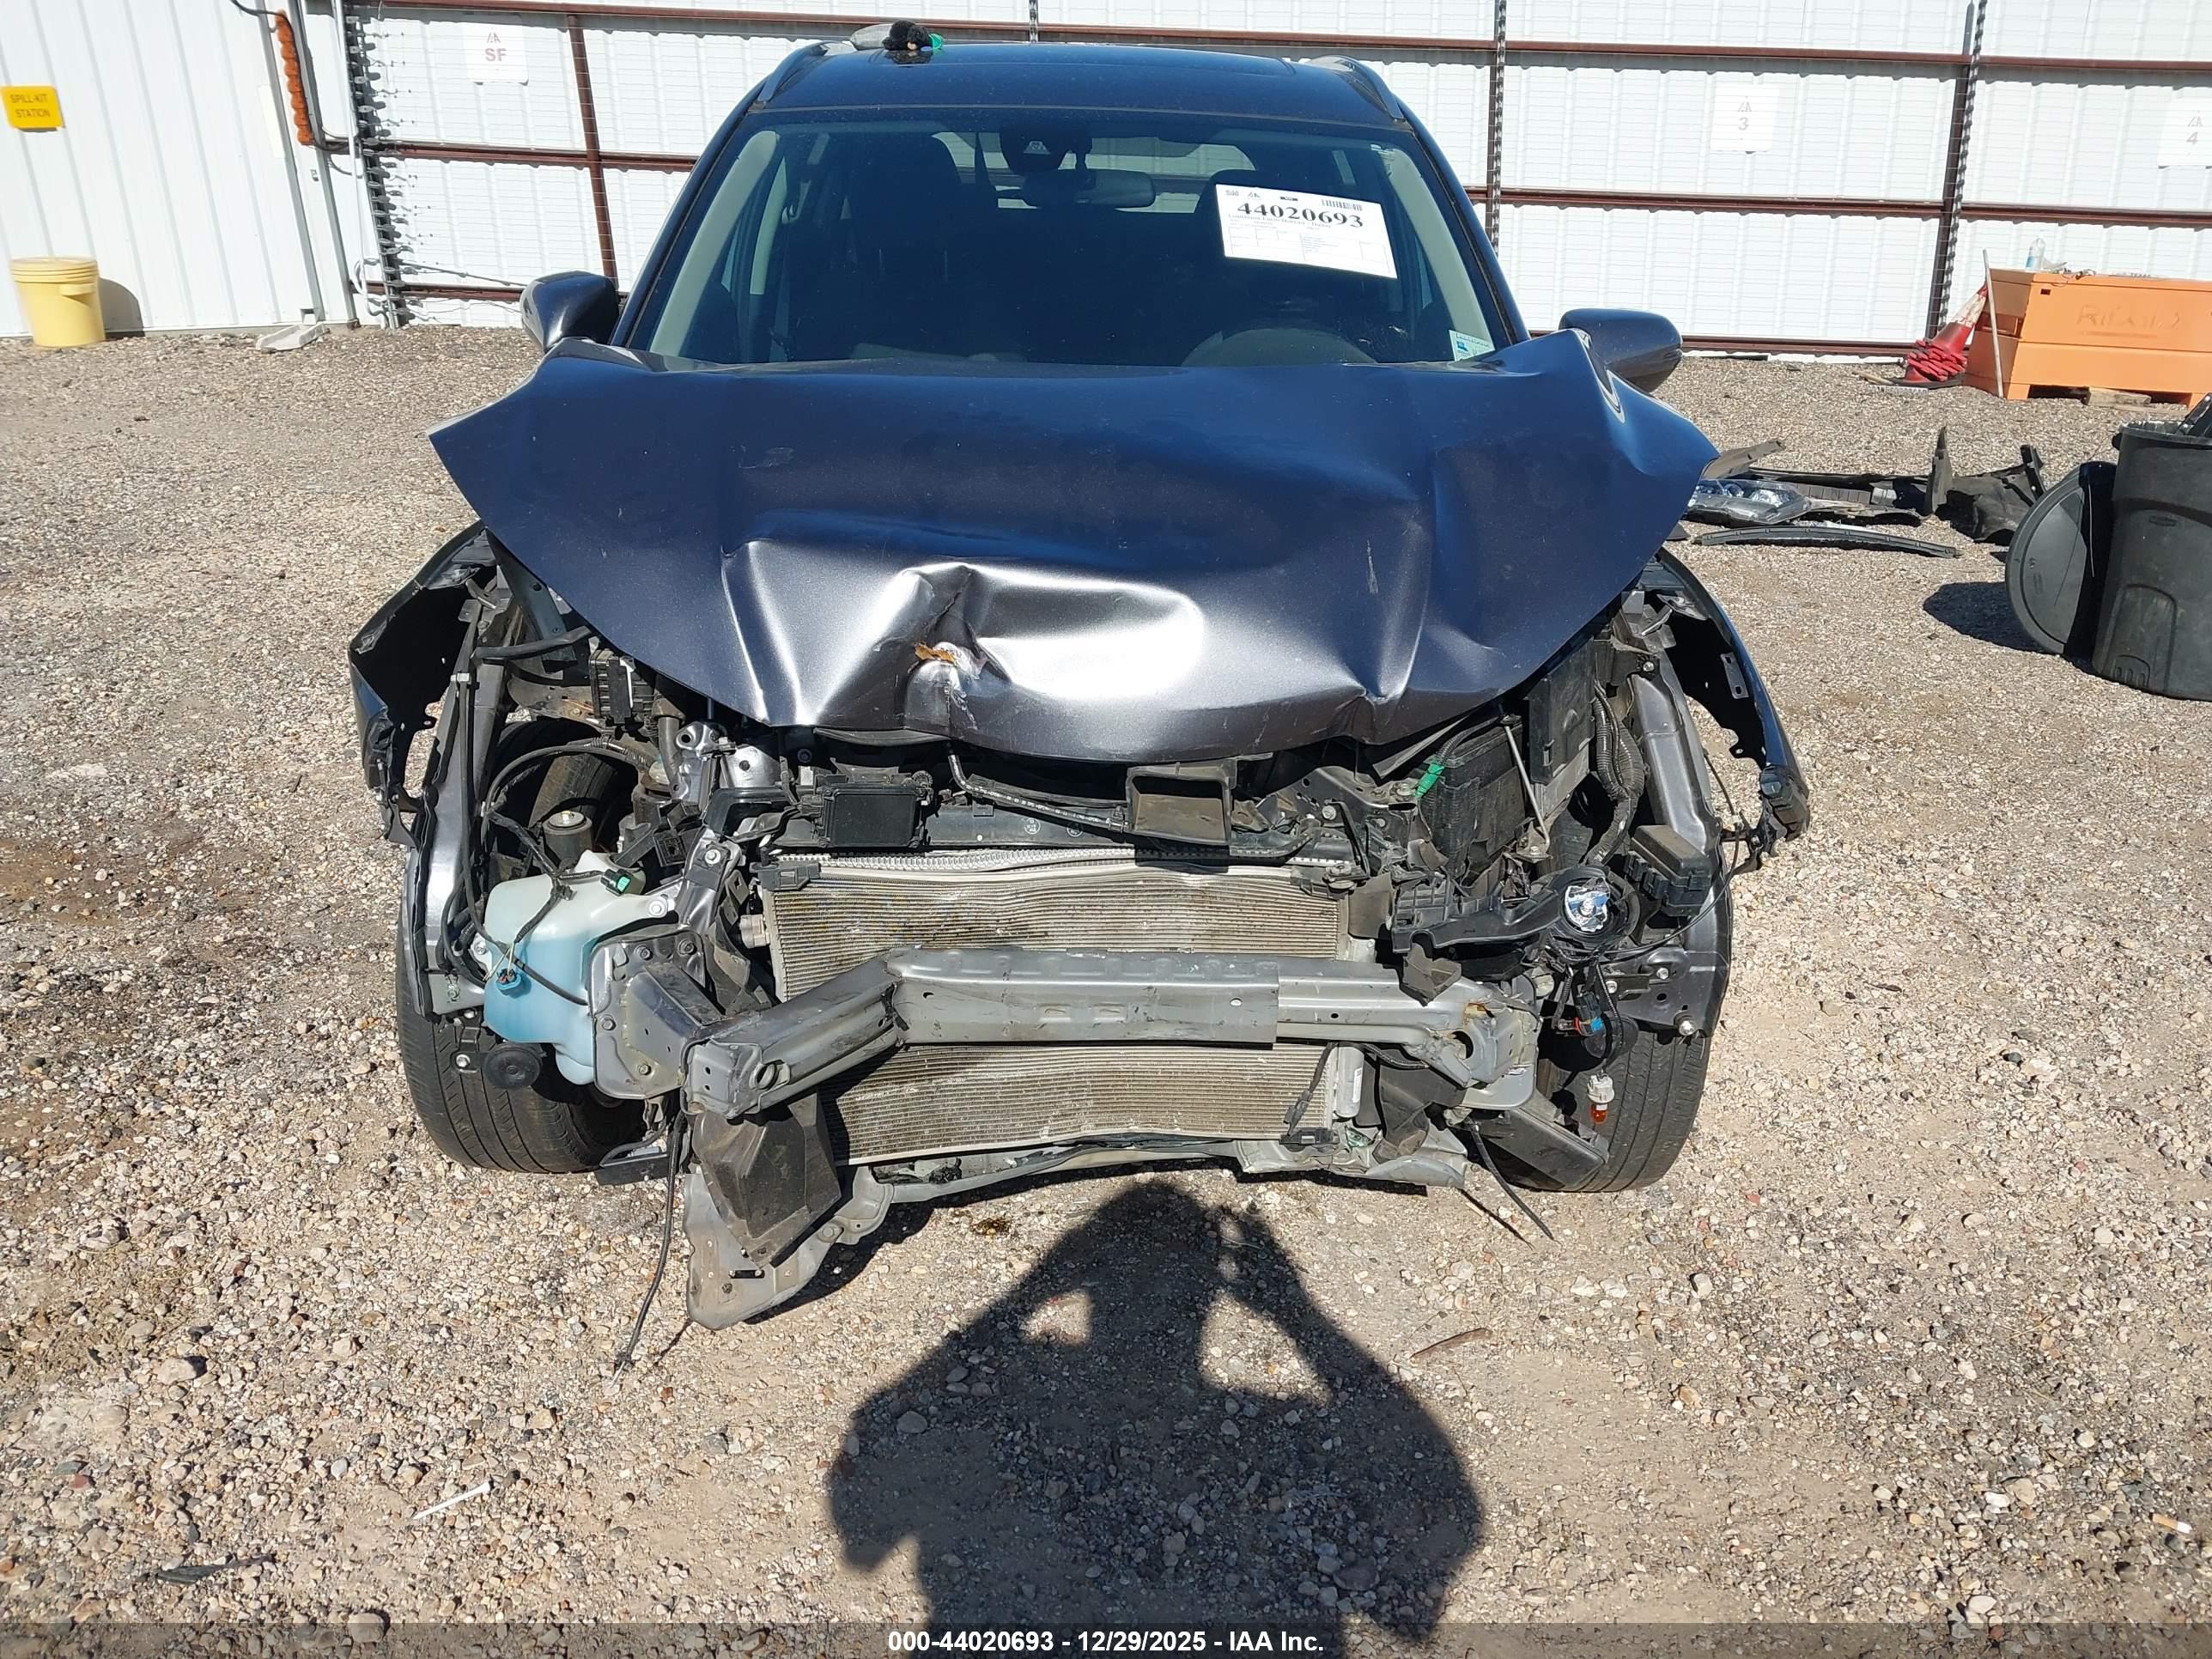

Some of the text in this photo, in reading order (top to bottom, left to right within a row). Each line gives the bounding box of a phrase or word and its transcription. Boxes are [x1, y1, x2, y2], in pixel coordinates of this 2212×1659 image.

[485, 47, 507, 62] SF
[15, 108, 52, 118] STATION
[1738, 117, 1749, 131] 3
[2186, 131, 2199, 145] 4
[1237, 202, 1364, 228] 44020693
